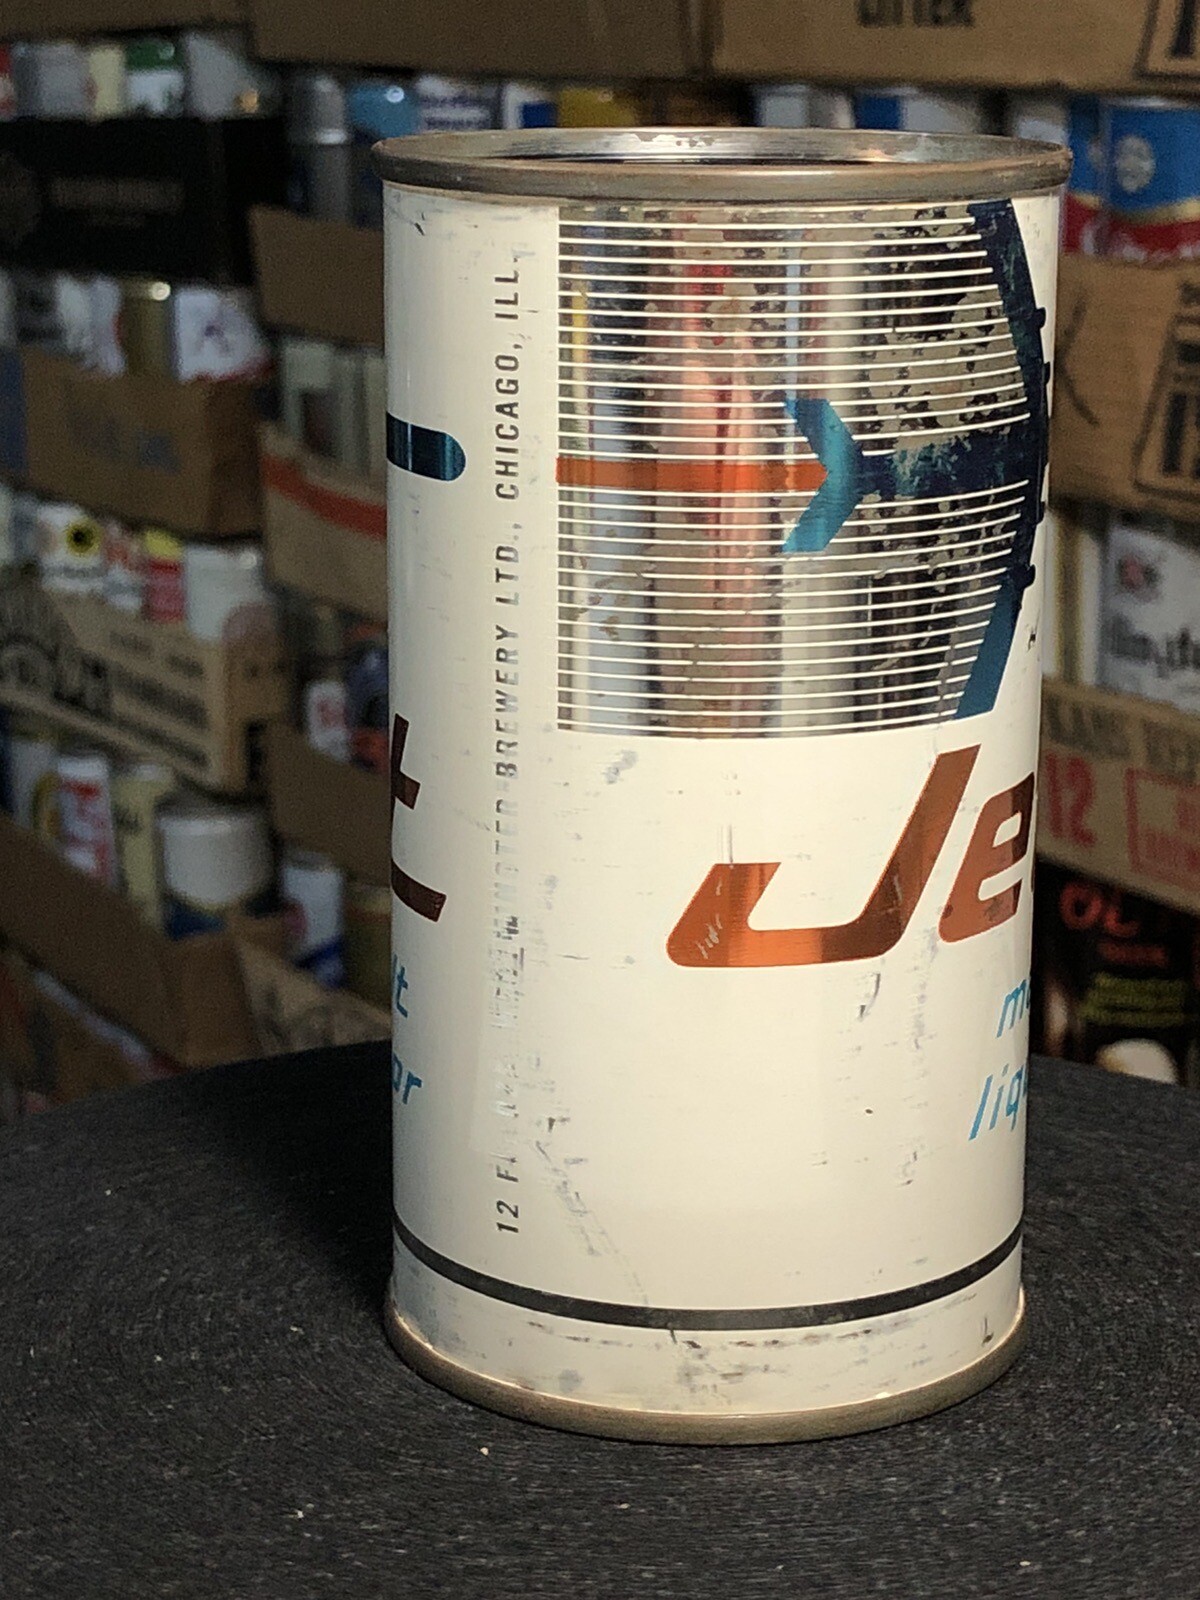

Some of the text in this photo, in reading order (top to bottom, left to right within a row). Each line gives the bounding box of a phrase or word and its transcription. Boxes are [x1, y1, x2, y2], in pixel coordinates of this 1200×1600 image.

[494, 257, 519, 321] ILL.
[494, 343, 523, 500] CHICAGO,
[494, 523, 522, 606] LTD.,
[494, 624, 519, 778] BREWERY
[666, 743, 1035, 967] Je
[495, 1199, 519, 1234] 12
